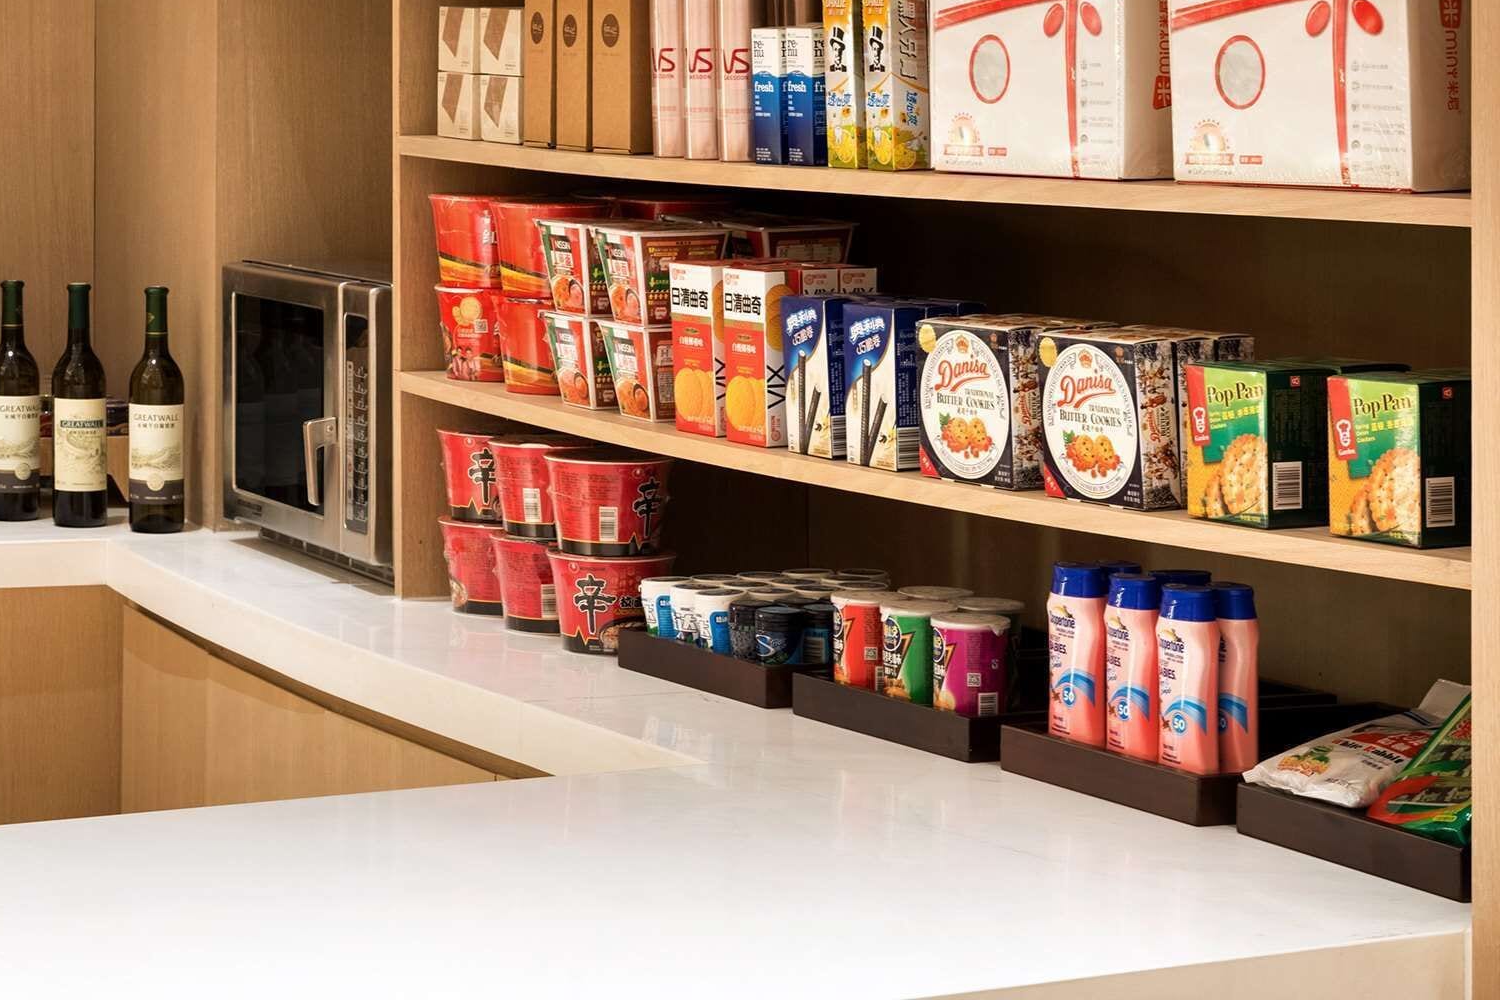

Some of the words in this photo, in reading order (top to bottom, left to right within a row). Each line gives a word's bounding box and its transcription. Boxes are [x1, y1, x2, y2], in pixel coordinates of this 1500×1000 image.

[723, 48, 750, 73] VS
[754, 81, 775, 93] fresh
[786, 81, 808, 93] fresh
[671, 287, 709, 311] 日清曲奇
[724, 292, 762, 316] 日清曲奇
[934, 356, 991, 392] Danisa
[1057, 373, 1117, 409] Danisa
[1208, 386, 1234, 407] Pop
[1236, 382, 1263, 400] Pan
[1354, 399, 1380, 418] Pop
[1382, 394, 1411, 411] Pan
[572, 572, 618, 636] 辛
[1062, 690, 1075, 701] 50
[1118, 704, 1131, 716] 50
[1172, 719, 1185, 731] 50
